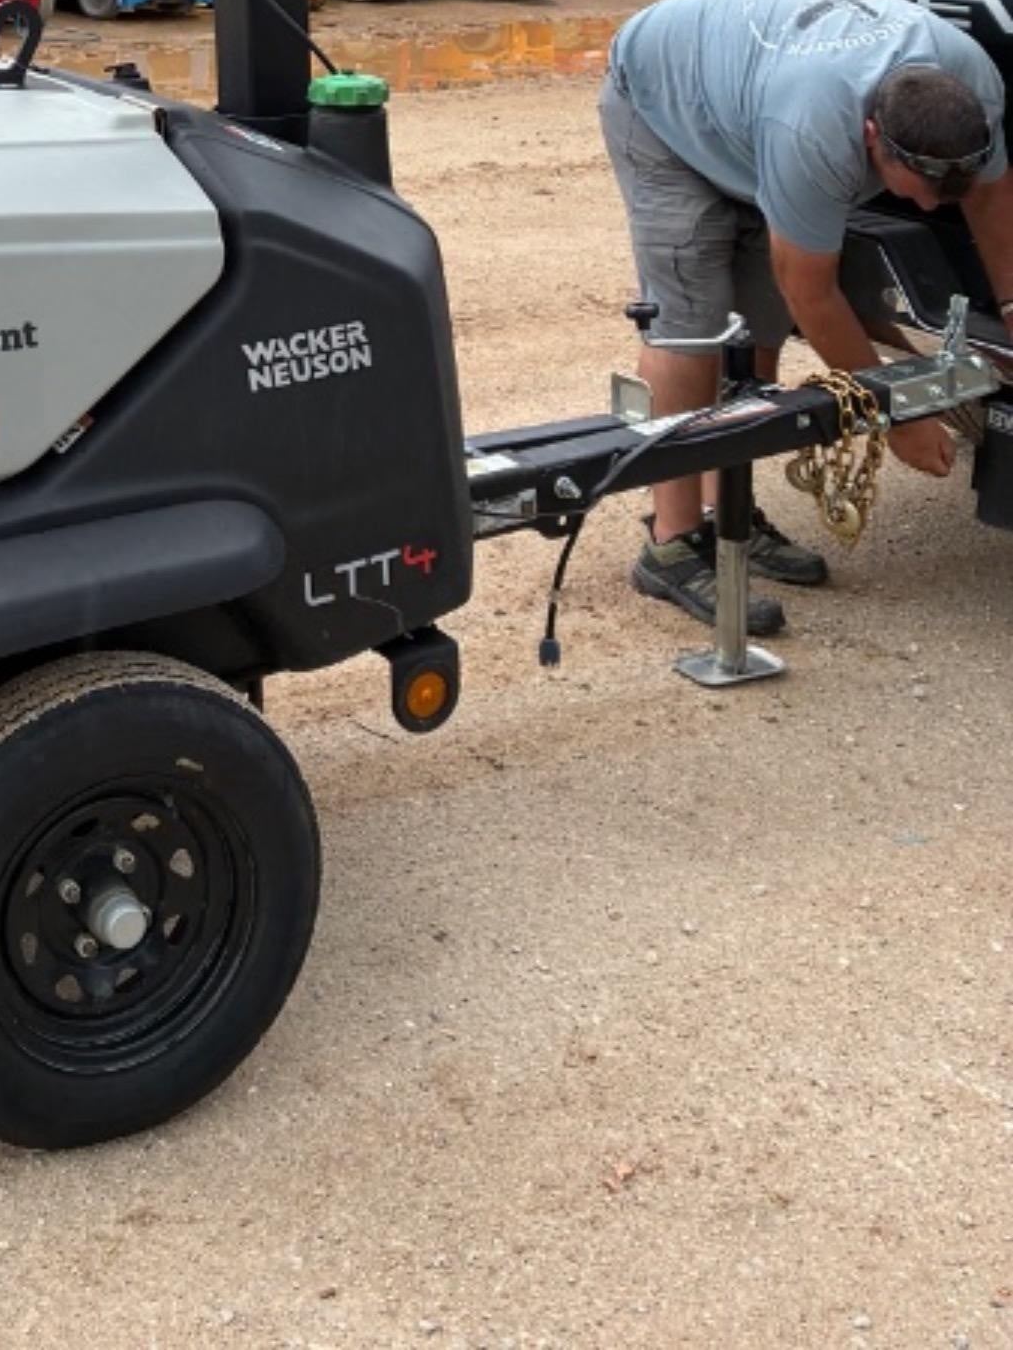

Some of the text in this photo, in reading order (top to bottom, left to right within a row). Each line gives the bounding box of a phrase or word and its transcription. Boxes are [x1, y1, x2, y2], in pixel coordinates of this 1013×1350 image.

[242, 320, 368, 366] WACKER
[247, 345, 372, 392] NEUSON
[303, 545, 436, 606] LTT4
